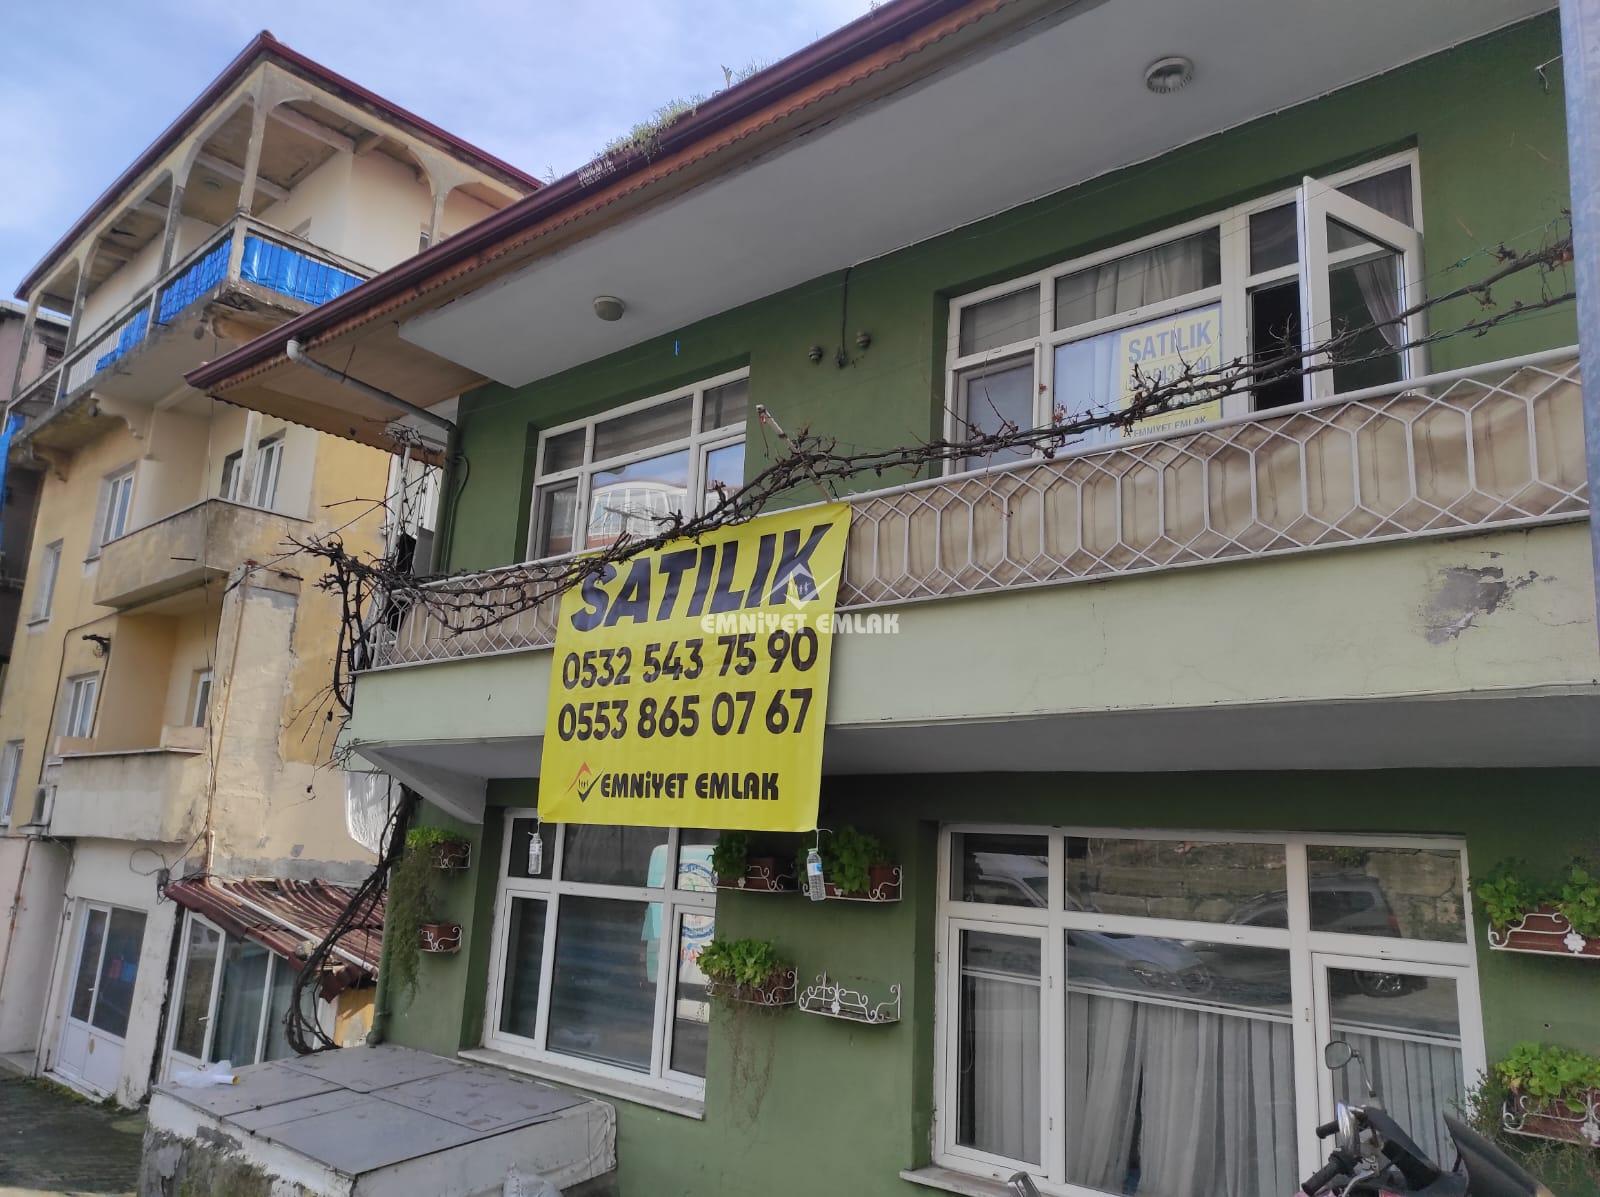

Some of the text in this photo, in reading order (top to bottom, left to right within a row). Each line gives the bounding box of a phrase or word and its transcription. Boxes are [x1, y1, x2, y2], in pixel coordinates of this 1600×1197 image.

[1128, 320, 1211, 363] SATILIK
[571, 523, 833, 632] SATILIK
[562, 626, 819, 689] 0532 543 75 90
[557, 687, 814, 742] 0553 865 07 67
[695, 772, 780, 801] EMLAK
